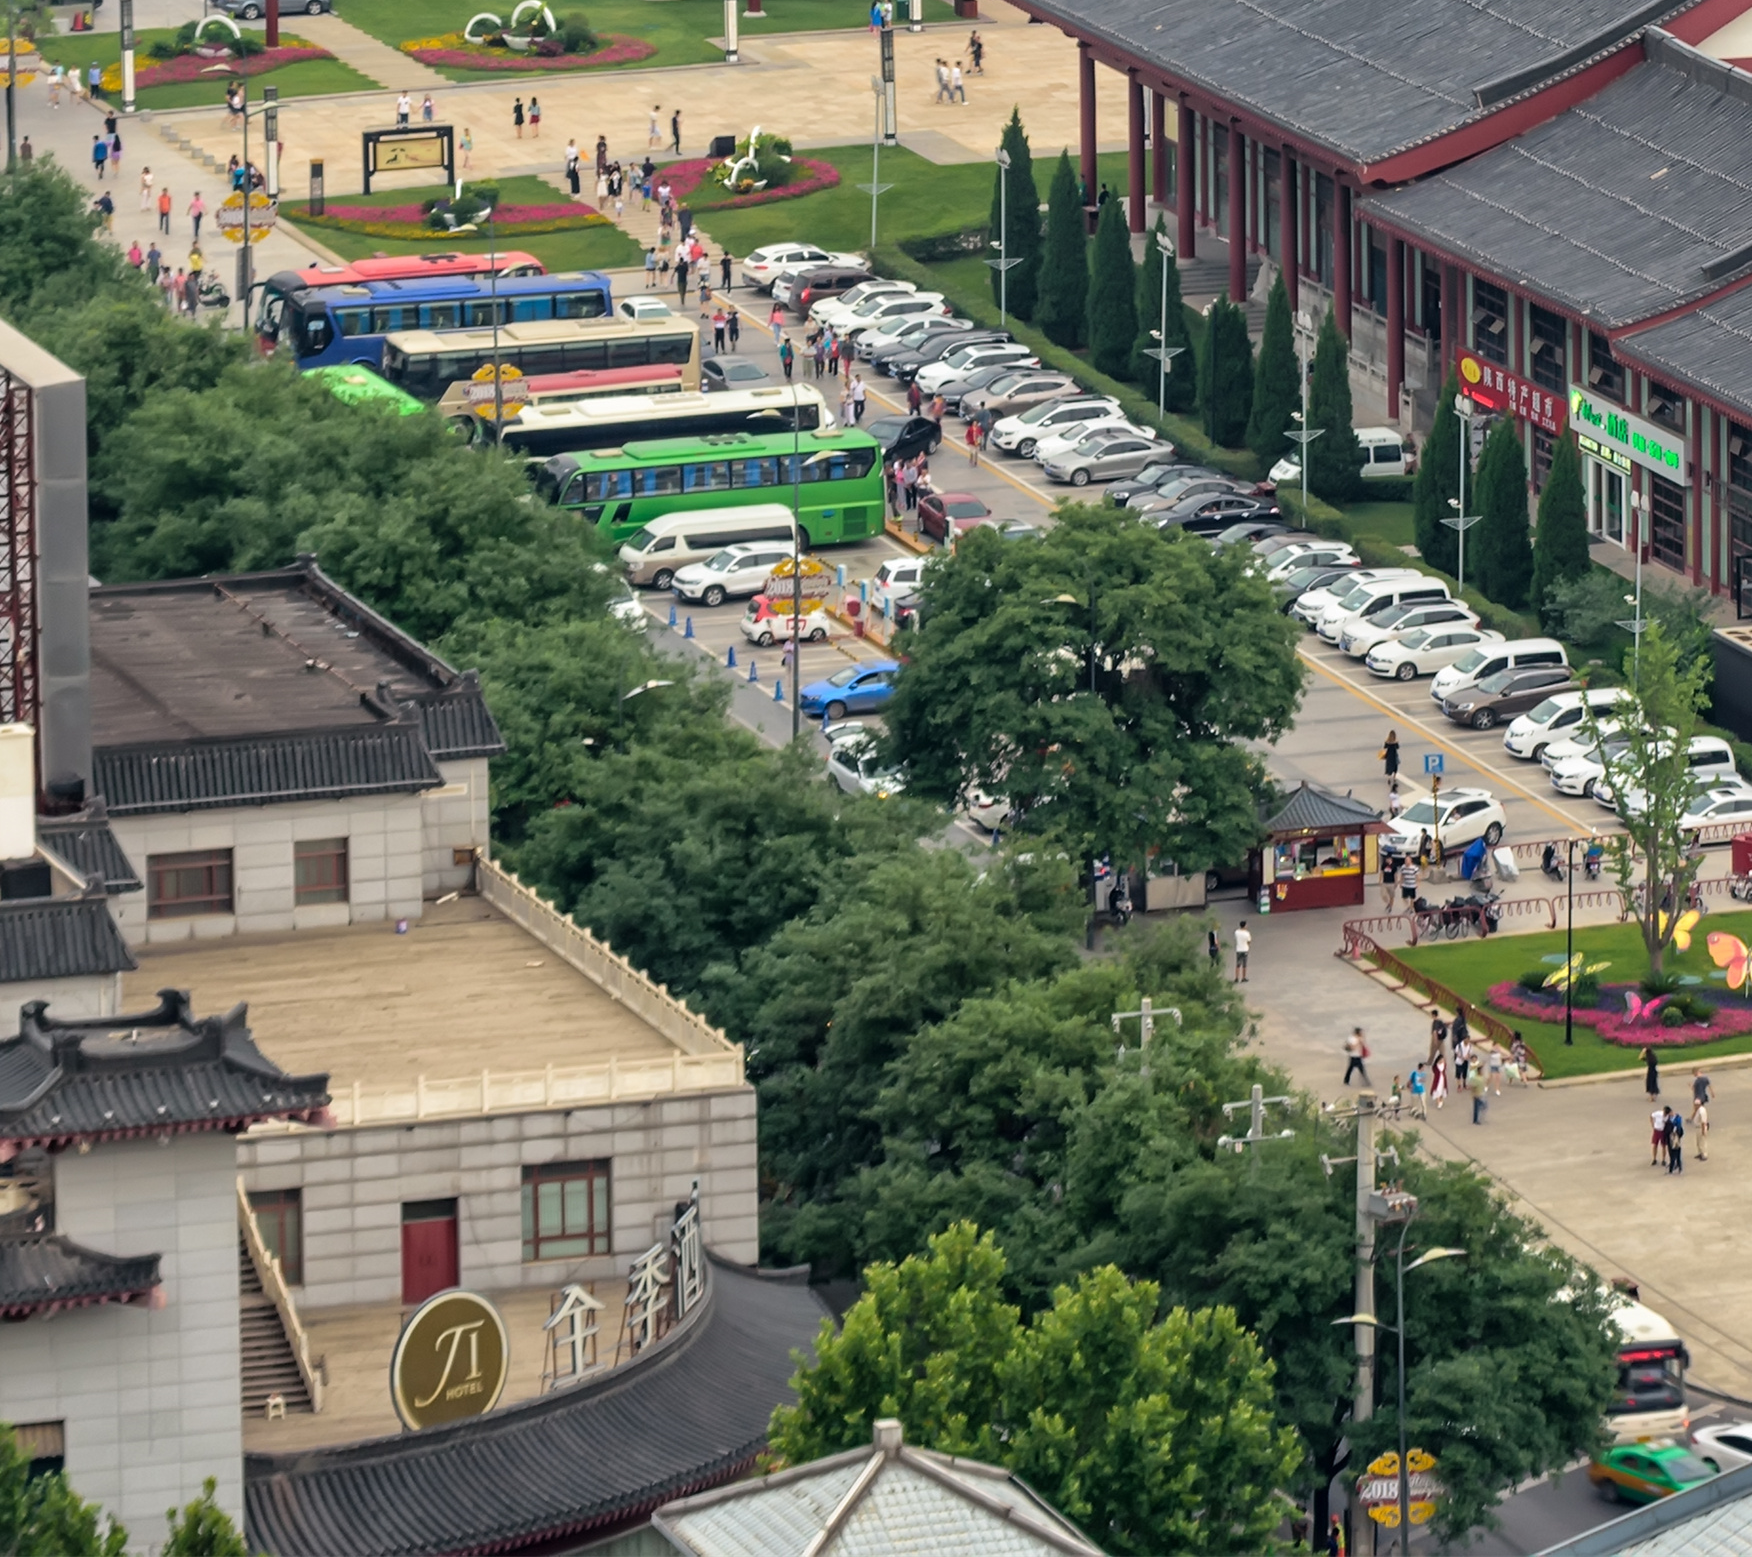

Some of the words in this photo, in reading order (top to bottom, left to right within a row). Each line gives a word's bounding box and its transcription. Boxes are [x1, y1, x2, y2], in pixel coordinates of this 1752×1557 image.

[1428, 756, 1440, 772] P
[446, 1380, 484, 1401] HOTEL
[1360, 1479, 1399, 1501] 2018
